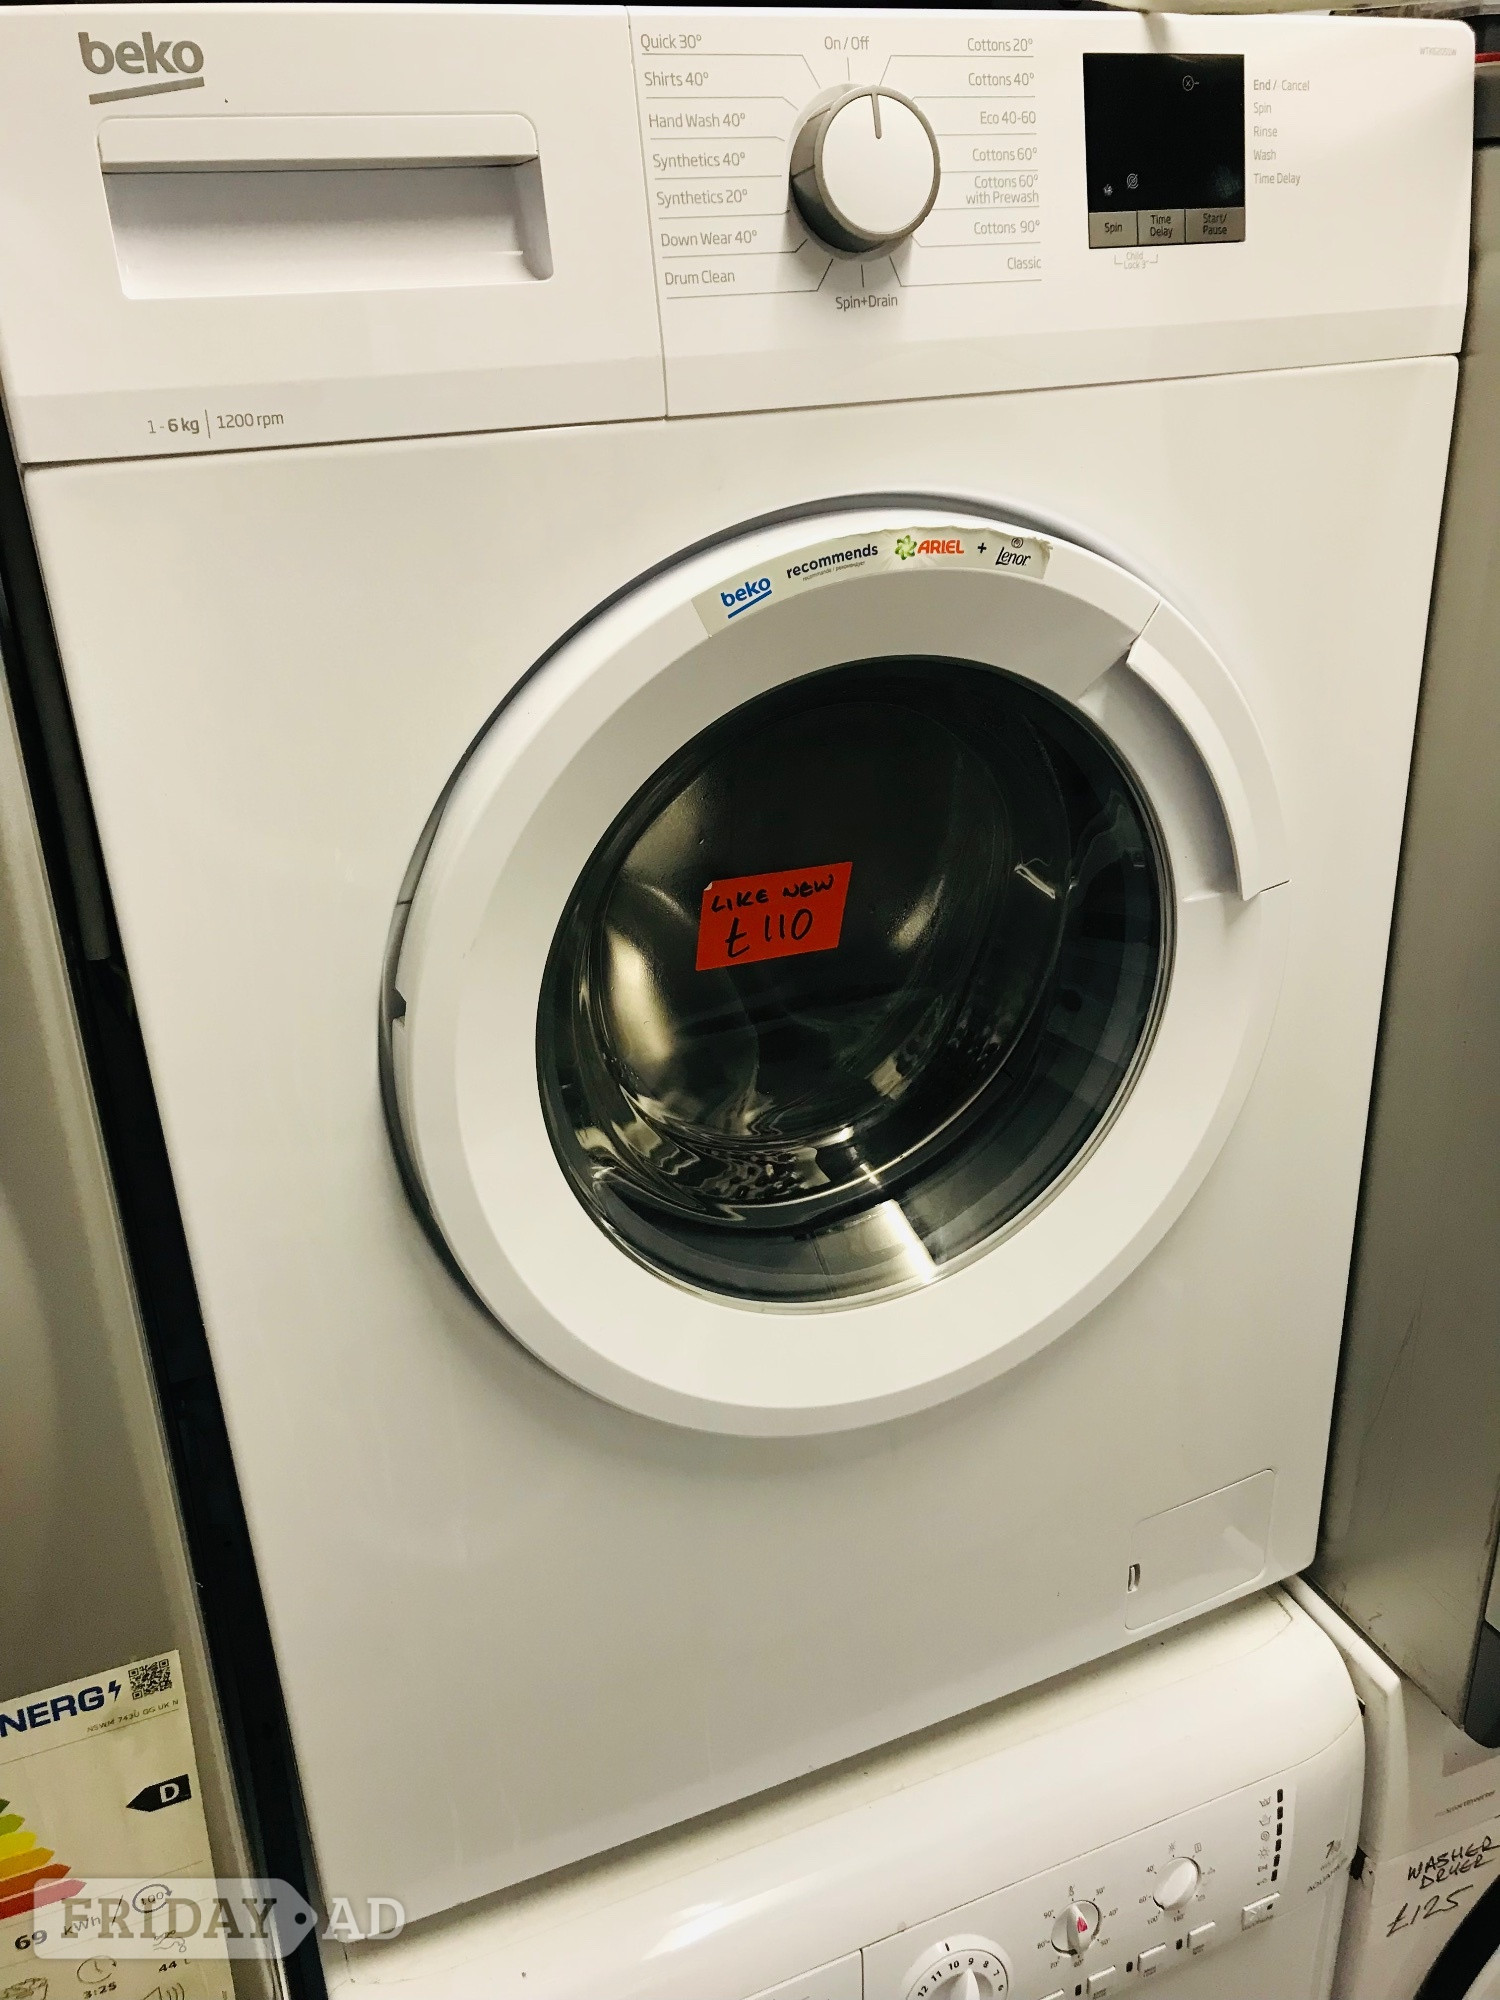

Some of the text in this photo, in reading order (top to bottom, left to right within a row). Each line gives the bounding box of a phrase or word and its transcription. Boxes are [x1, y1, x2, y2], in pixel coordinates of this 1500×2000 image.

[640, 33, 676, 51] Quick
[824, 36, 841, 50] On
[851, 36, 870, 51] Off
[967, 37, 1011, 52] Cottons
[78, 31, 204, 75] beko
[644, 71, 683, 86] Shirts
[968, 72, 1012, 86] Cottons
[1253, 79, 1271, 91] End
[1281, 79, 1310, 91] Cancel
[1253, 101, 1272, 116] Spin
[649, 113, 683, 128] Hand
[685, 113, 720, 127] Wash
[980, 110, 1037, 125] Eco 40-60
[1253, 125, 1278, 137] Rinse
[653, 152, 720, 171] Synthetics
[972, 148, 1016, 162] Cottons
[1253, 149, 1277, 161] Wash
[974, 175, 1017, 189] Cottons
[1253, 172, 1301, 186] Time Delay
[656, 189, 723, 208] Synthetics
[966, 190, 1039, 205] with Prewash
[1150, 214, 1172, 224] Time
[1202, 213, 1228, 224] Start/
[973, 221, 1016, 235] Cottons
[1104, 222, 1123, 235] Spin
[1150, 226, 1173, 239] Delay
[1202, 225, 1228, 235] Pause
[661, 233, 698, 247] Down
[700, 231, 732, 246] Wear
[1007, 256, 1042, 270] Classic
[665, 270, 735, 286] Drum Clean
[836, 294, 898, 312] Spin+Drain
[720, 577, 771, 608] beko
[786, 543, 879, 579] recommends
[917, 539, 965, 554] ARIEL
[995, 549, 1031, 567] Lenor
[711, 873, 835, 913] LIKE NEW
[725, 908, 814, 959] £110
[159, 1782, 180, 1803] D
[1407, 1835, 1500, 1881] WASHER
[1419, 1854, 1496, 1889] DRYER
[1386, 1884, 1474, 1938] £125
[14, 1929, 48, 1950] 69
[63, 1915, 101, 1936] kWh
[158, 1960, 177, 1972] 44
[917, 1985, 929, 1997] 12
[931, 1970, 942, 1982] 11
[948, 1960, 960, 1970] 10
[968, 1957, 974, 1965] 9
[983, 1960, 989, 1968] 8
